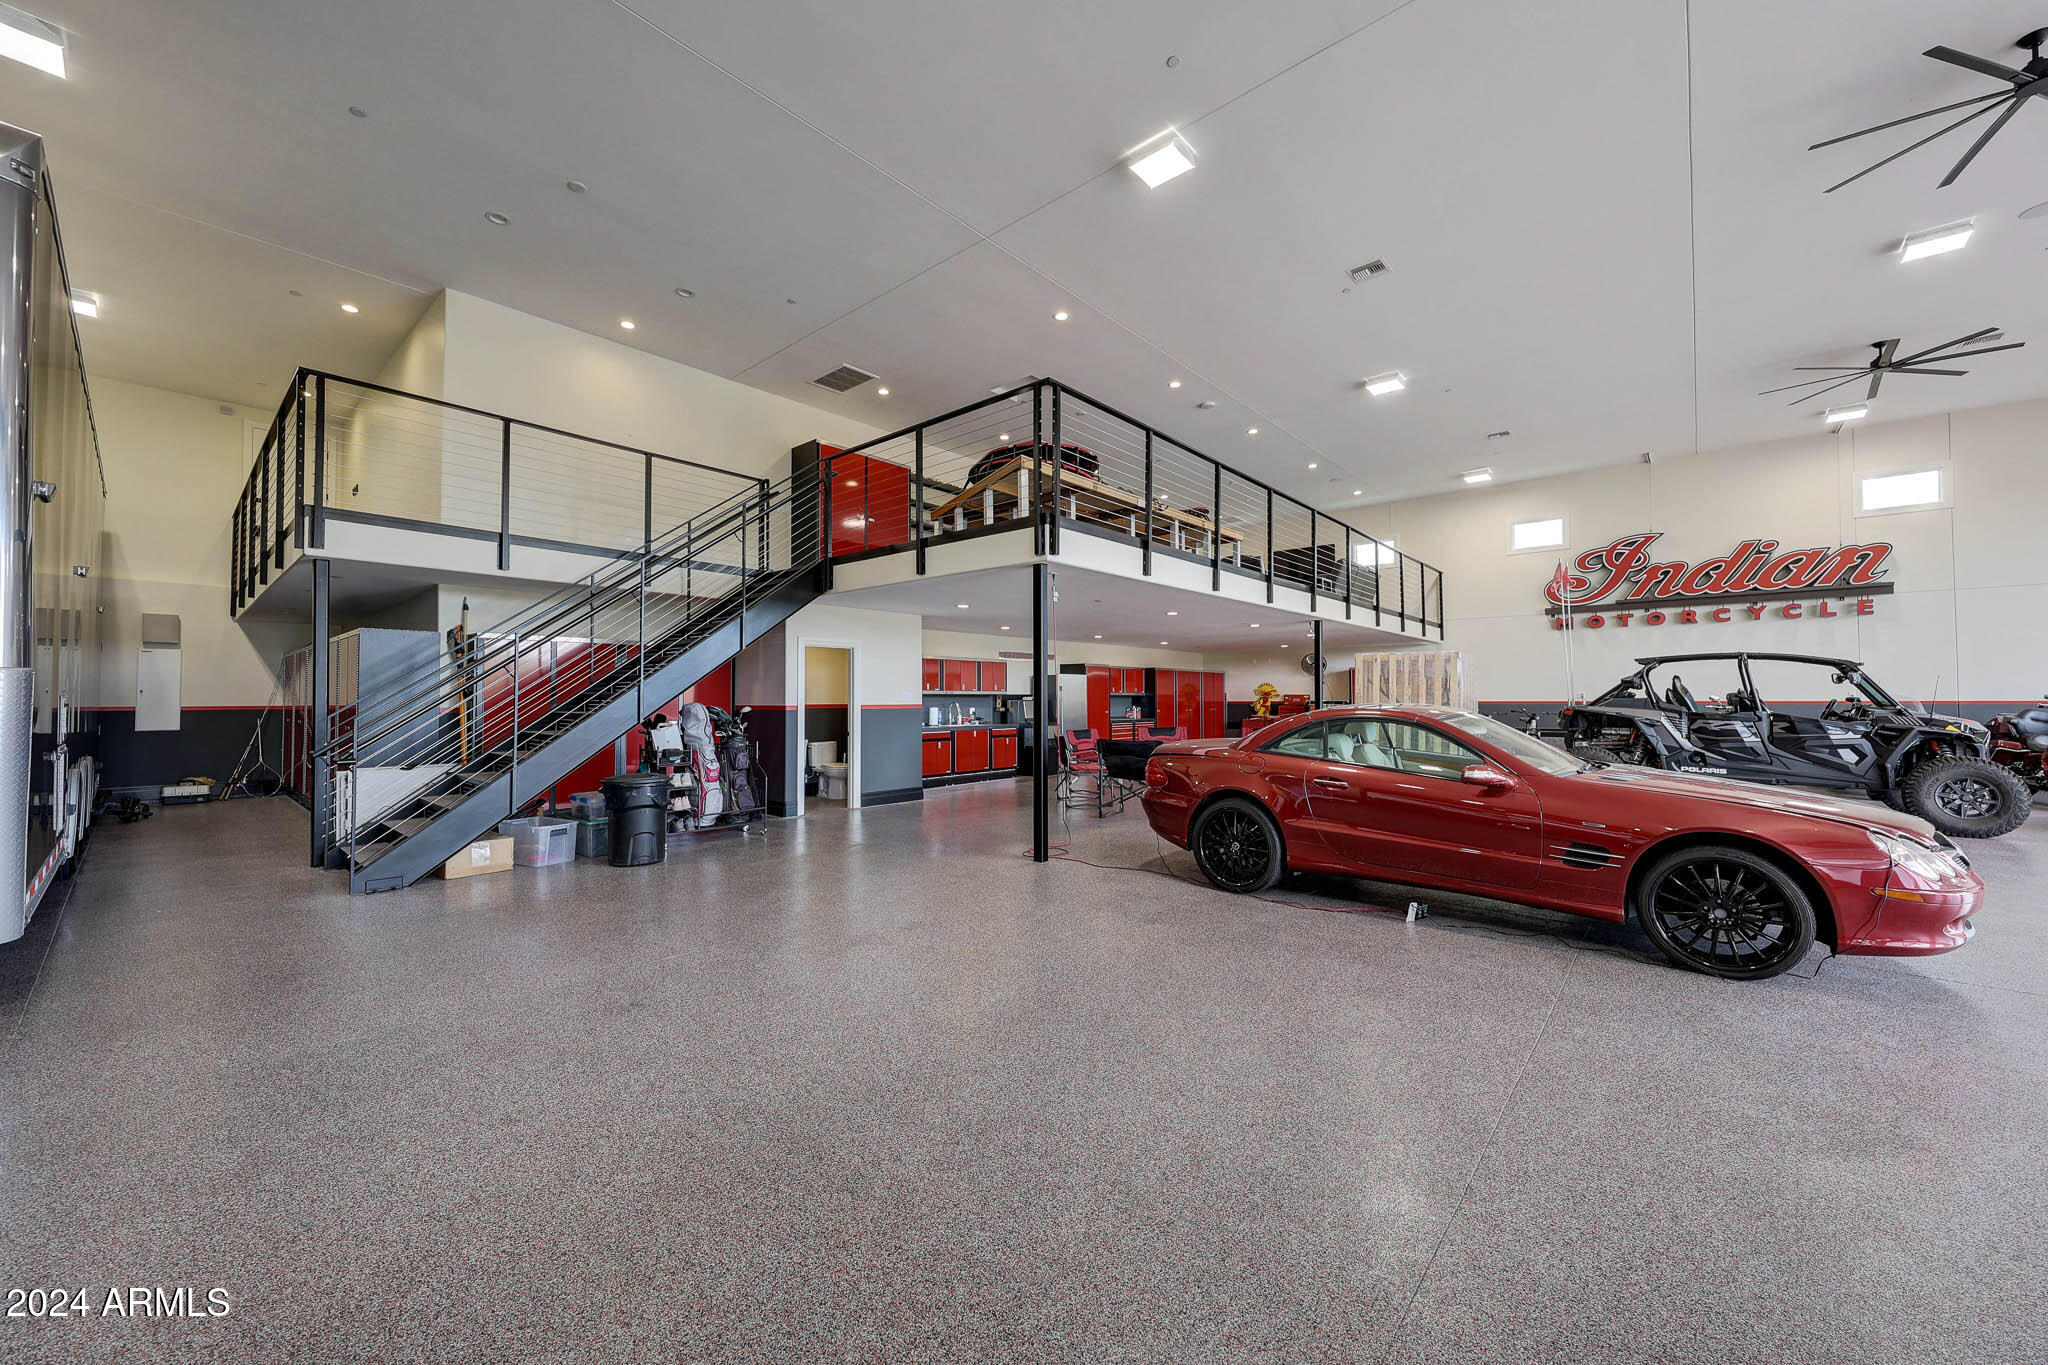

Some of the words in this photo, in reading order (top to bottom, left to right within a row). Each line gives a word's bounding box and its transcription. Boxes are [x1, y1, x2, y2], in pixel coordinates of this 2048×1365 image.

[1543, 532, 1894, 606] Indian
[1556, 599, 1875, 630] MOTORCYCLE
[1680, 765, 1728, 774] POLARIS
